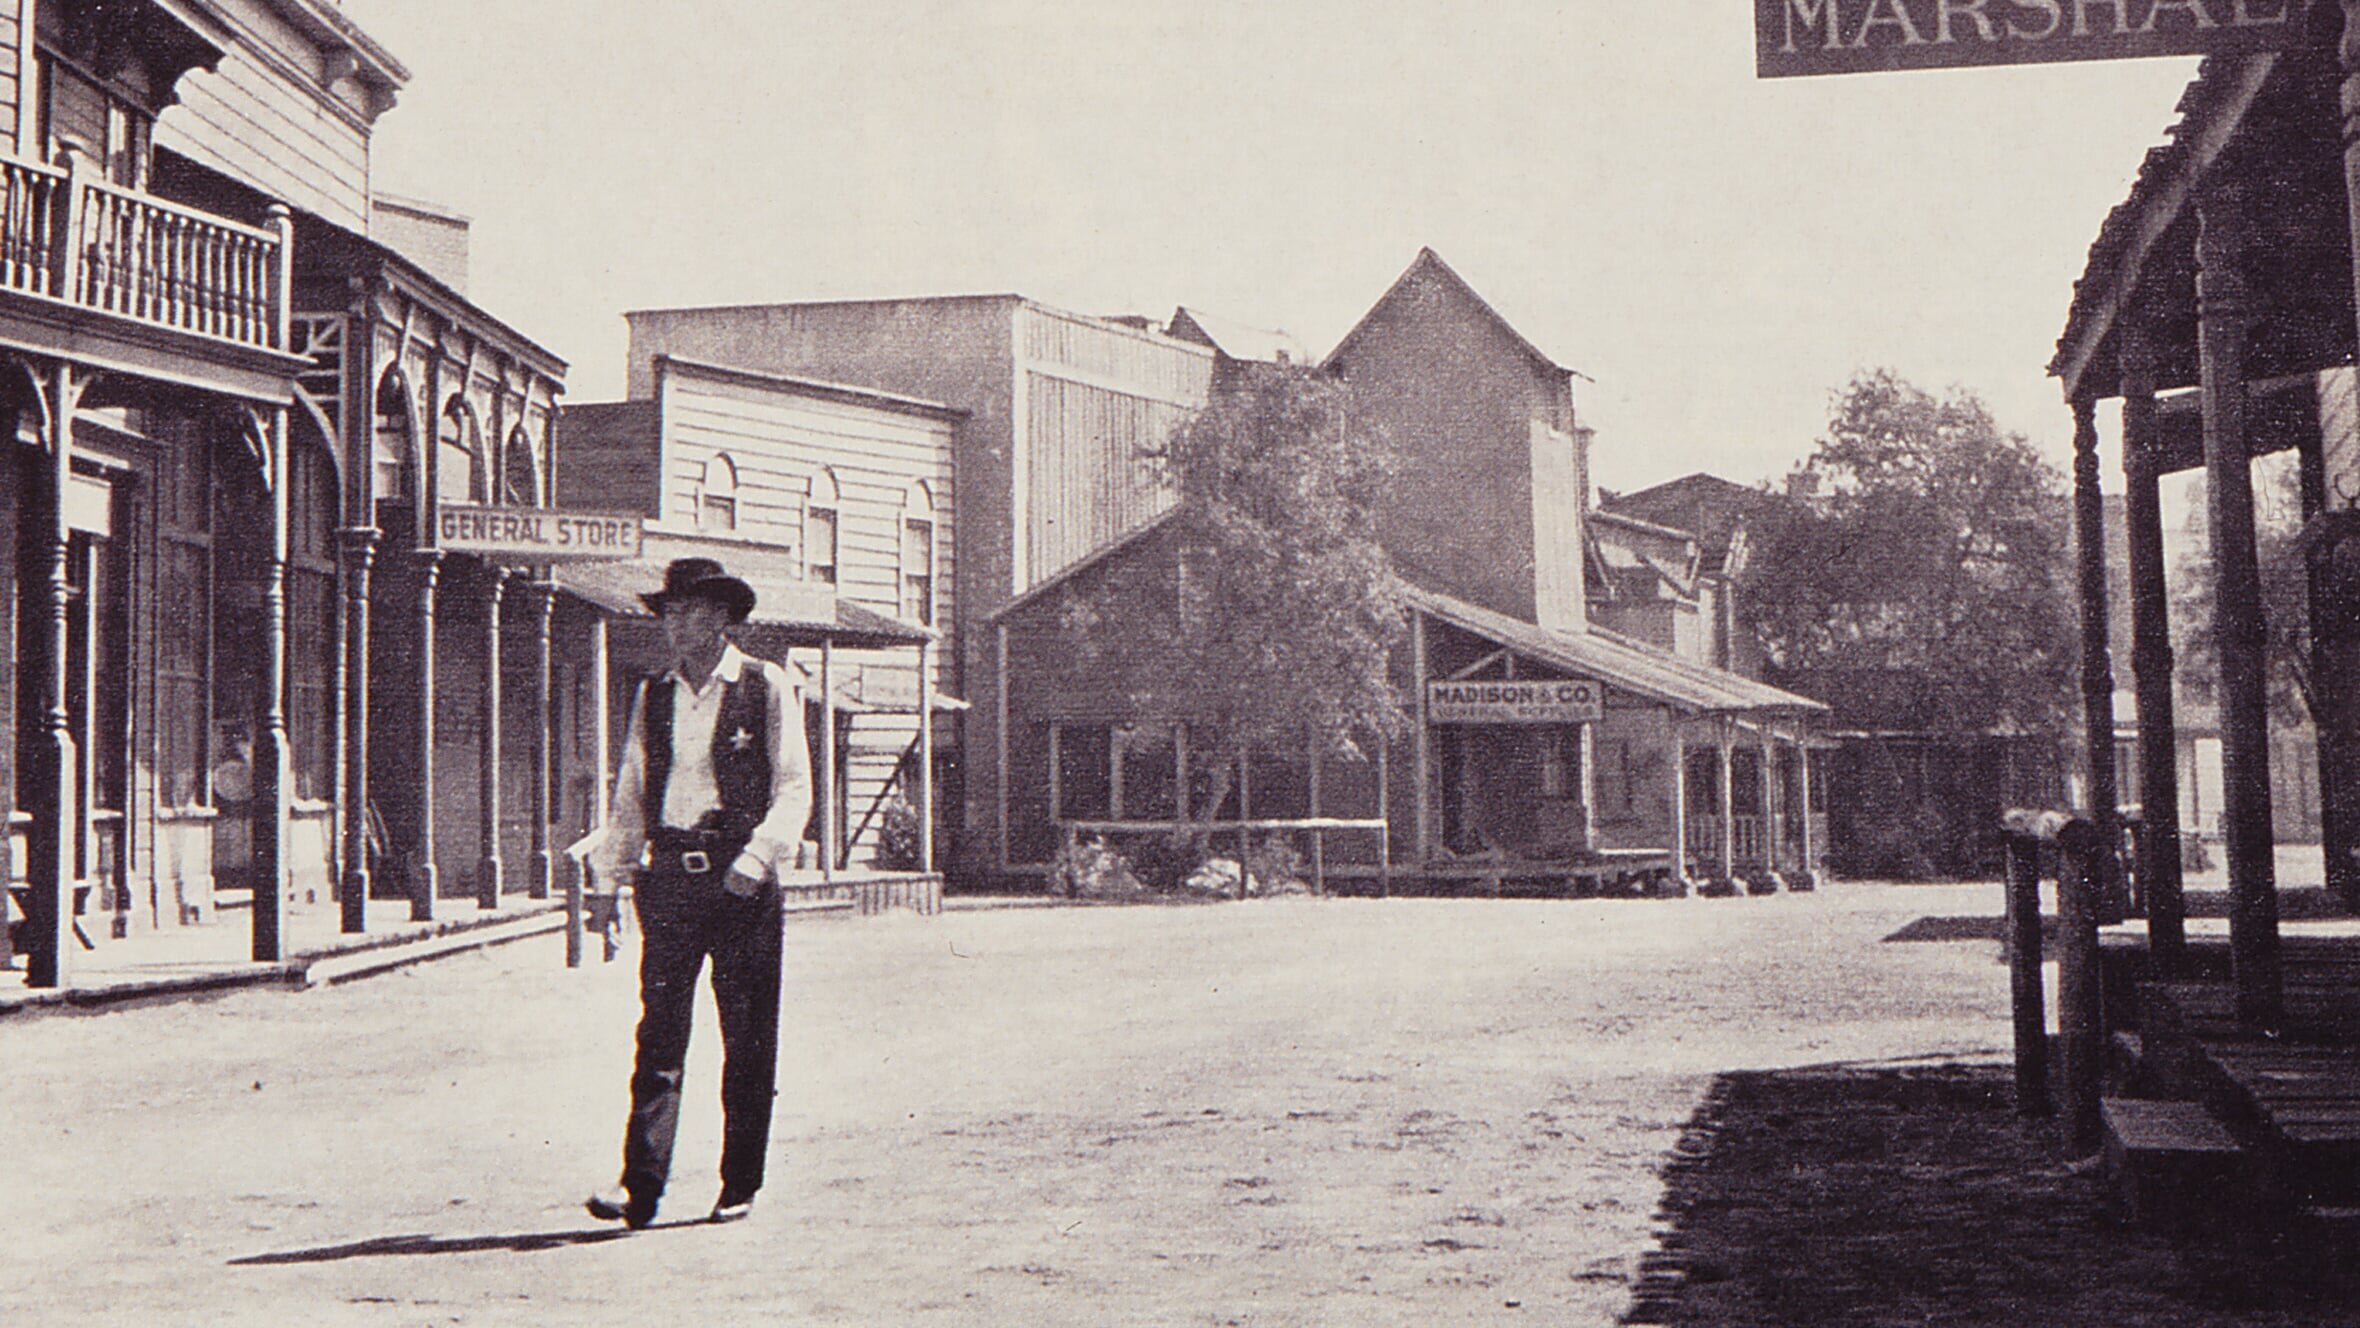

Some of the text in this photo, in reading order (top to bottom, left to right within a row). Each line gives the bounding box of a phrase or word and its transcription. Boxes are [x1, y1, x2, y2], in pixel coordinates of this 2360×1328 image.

[440, 513, 632, 546] GENERAL STORE
[1434, 687, 1534, 704] MADISON
[1557, 686, 1597, 704] CO.
